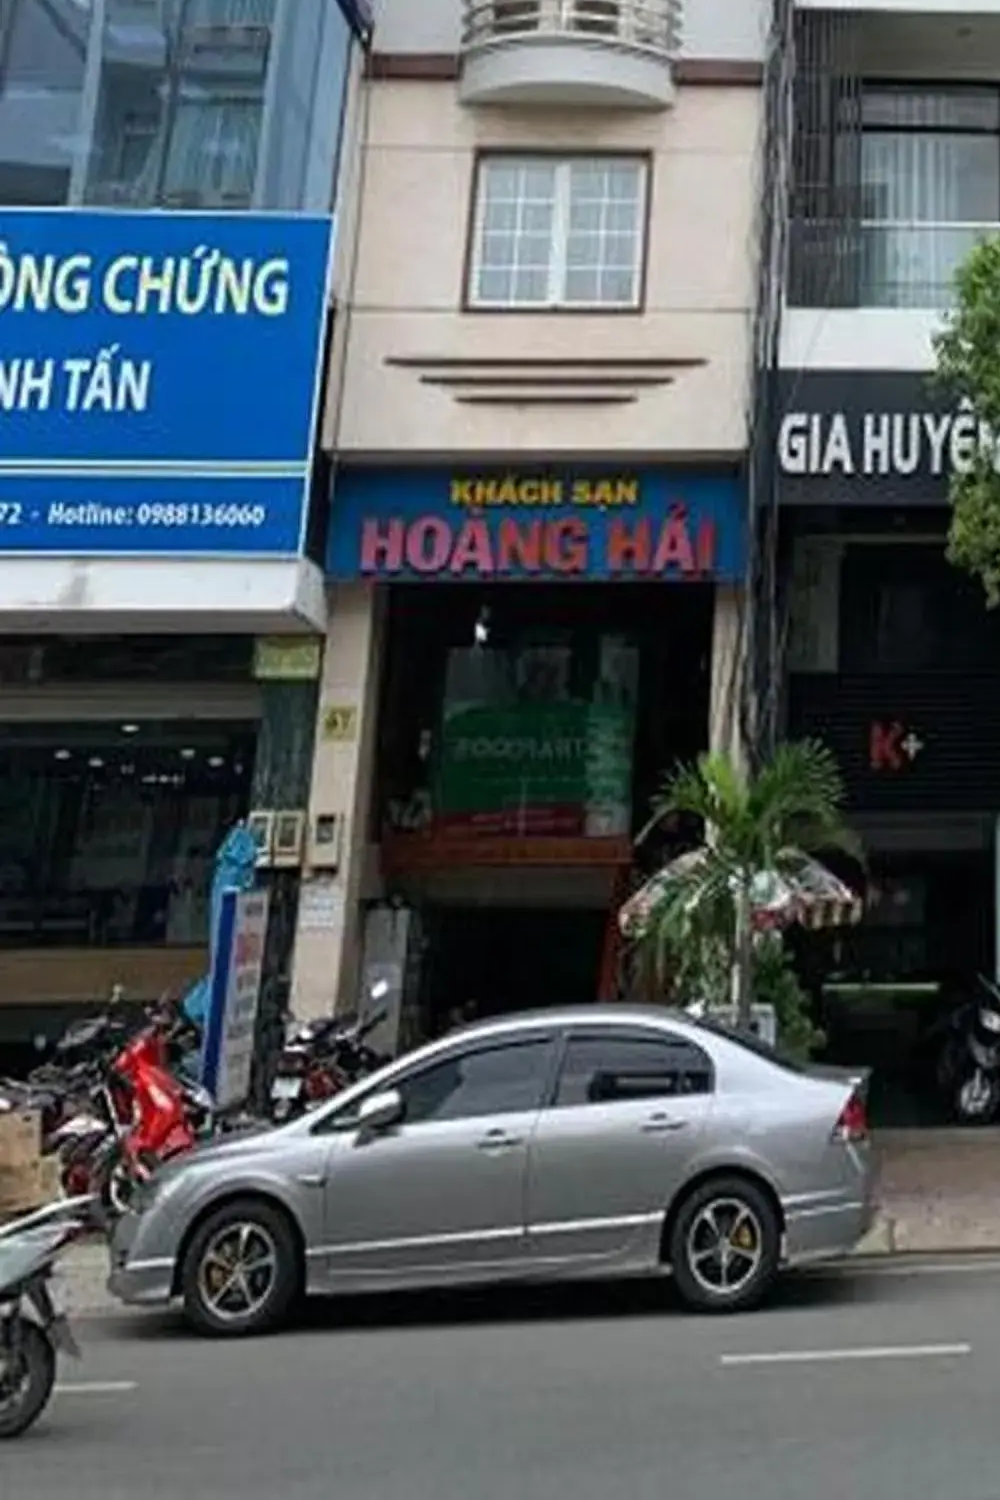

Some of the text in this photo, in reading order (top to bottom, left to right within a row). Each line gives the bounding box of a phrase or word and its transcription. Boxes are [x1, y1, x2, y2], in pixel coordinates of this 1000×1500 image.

[103, 244, 290, 315] CHỨNG
[62, 343, 151, 412] TẤN
[778, 411, 853, 475] GIA
[48, 502, 133, 527] Hotline:
[137, 503, 265, 527] 0988136060
[451, 476, 563, 505] KHÁCH
[360, 500, 717, 574] HOÀNG HẢI
